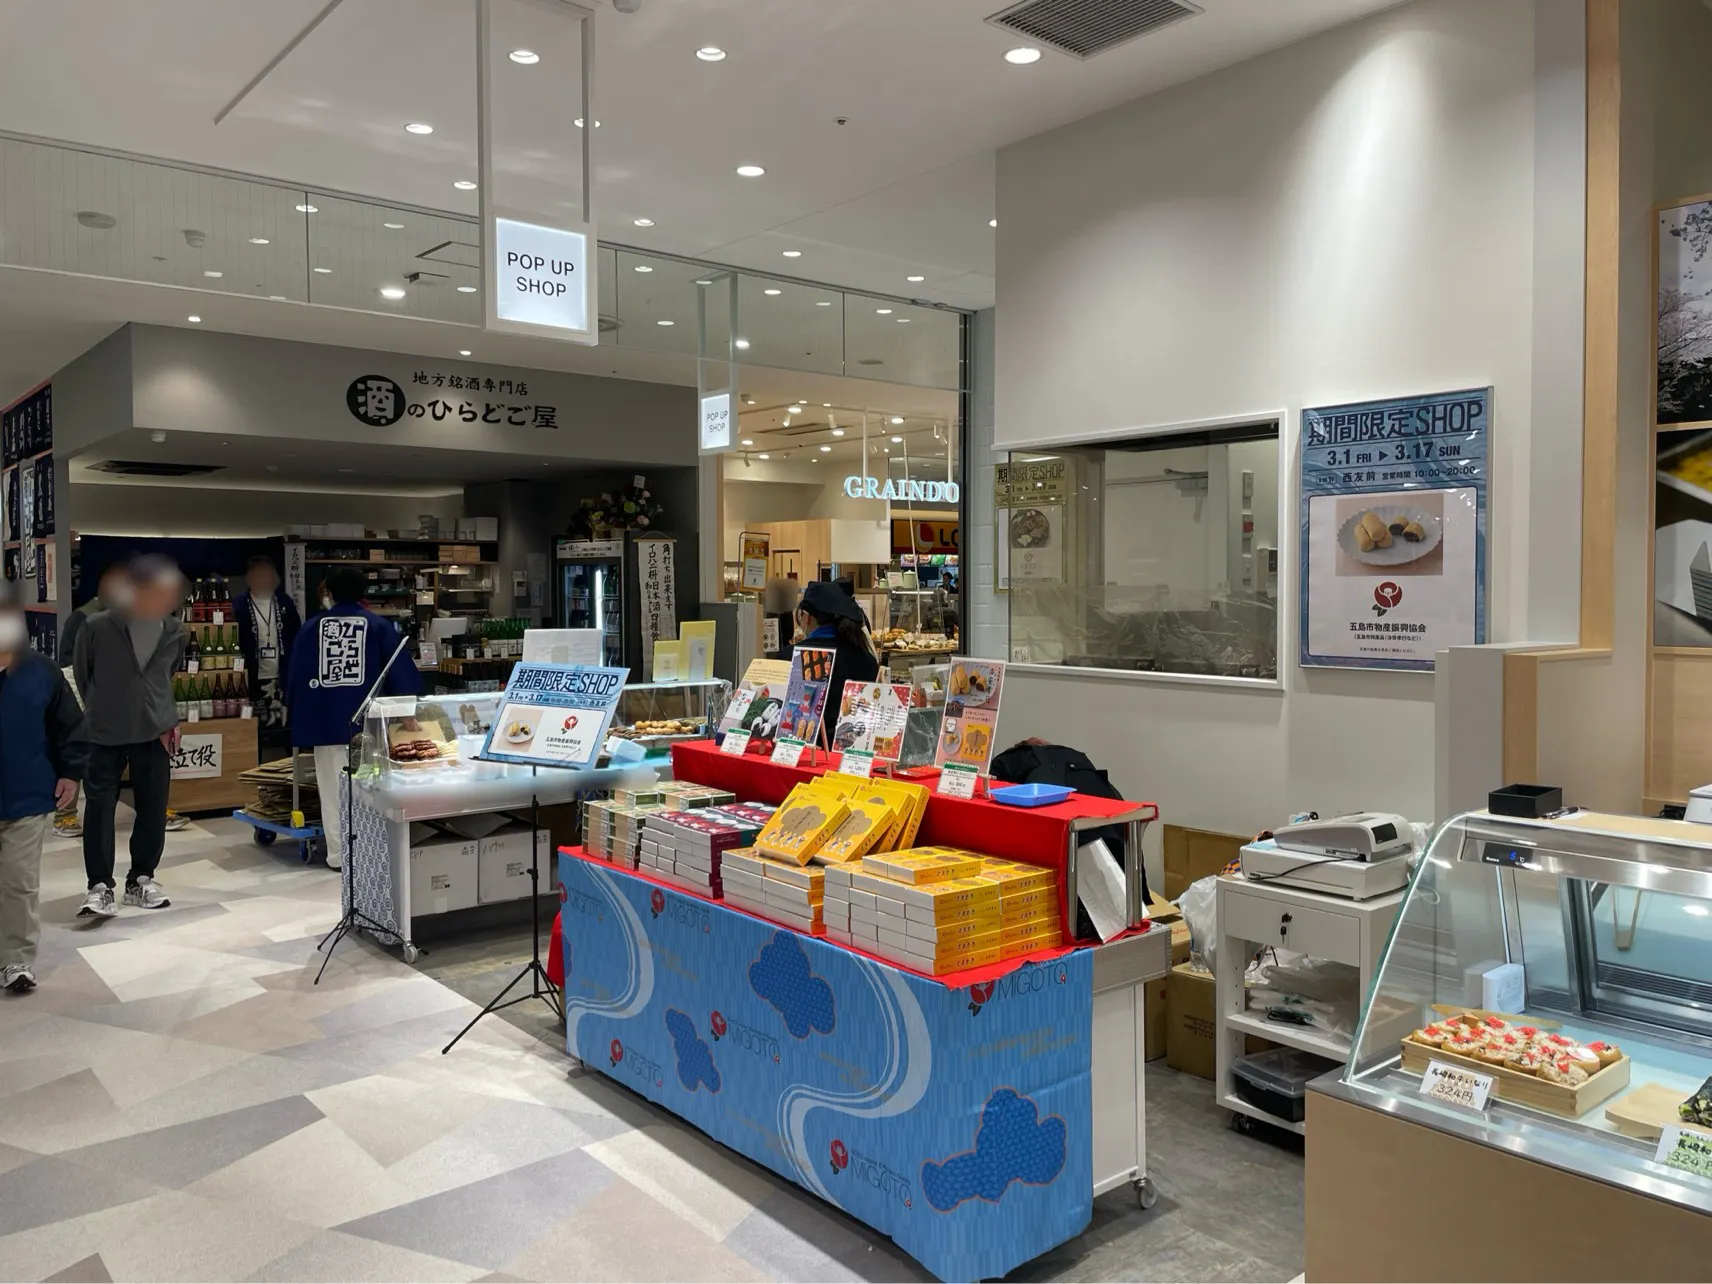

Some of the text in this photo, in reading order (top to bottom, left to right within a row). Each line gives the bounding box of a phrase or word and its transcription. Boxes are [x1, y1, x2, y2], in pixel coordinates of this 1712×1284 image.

[507, 251, 575, 276] POP UP
[516, 276, 567, 297] SHOP
[412, 370, 528, 396] 地方銘酒専門店
[706, 410, 729, 421] POP UP
[1307, 400, 1483, 447] 期間限定SHOP
[708, 422, 726, 433] SHOP
[1327, 441, 1461, 466] 3.1 FRI 3.17 SUN
[1342, 471, 1376, 483] 西友前
[1381, 471, 1411, 480] 営業時間
[1349, 621, 1427, 634] 五島市物産振興協会
[512, 668, 620, 696] 期間限定SHOP
[508, 691, 519, 700] 3.1
[528, 693, 543, 702] 3.17
[169, 743, 217, 770] 立て役
[1431, 1067, 1489, 1090] 長崎和牛いなり
[1436, 1084, 1474, 1102] 324円
